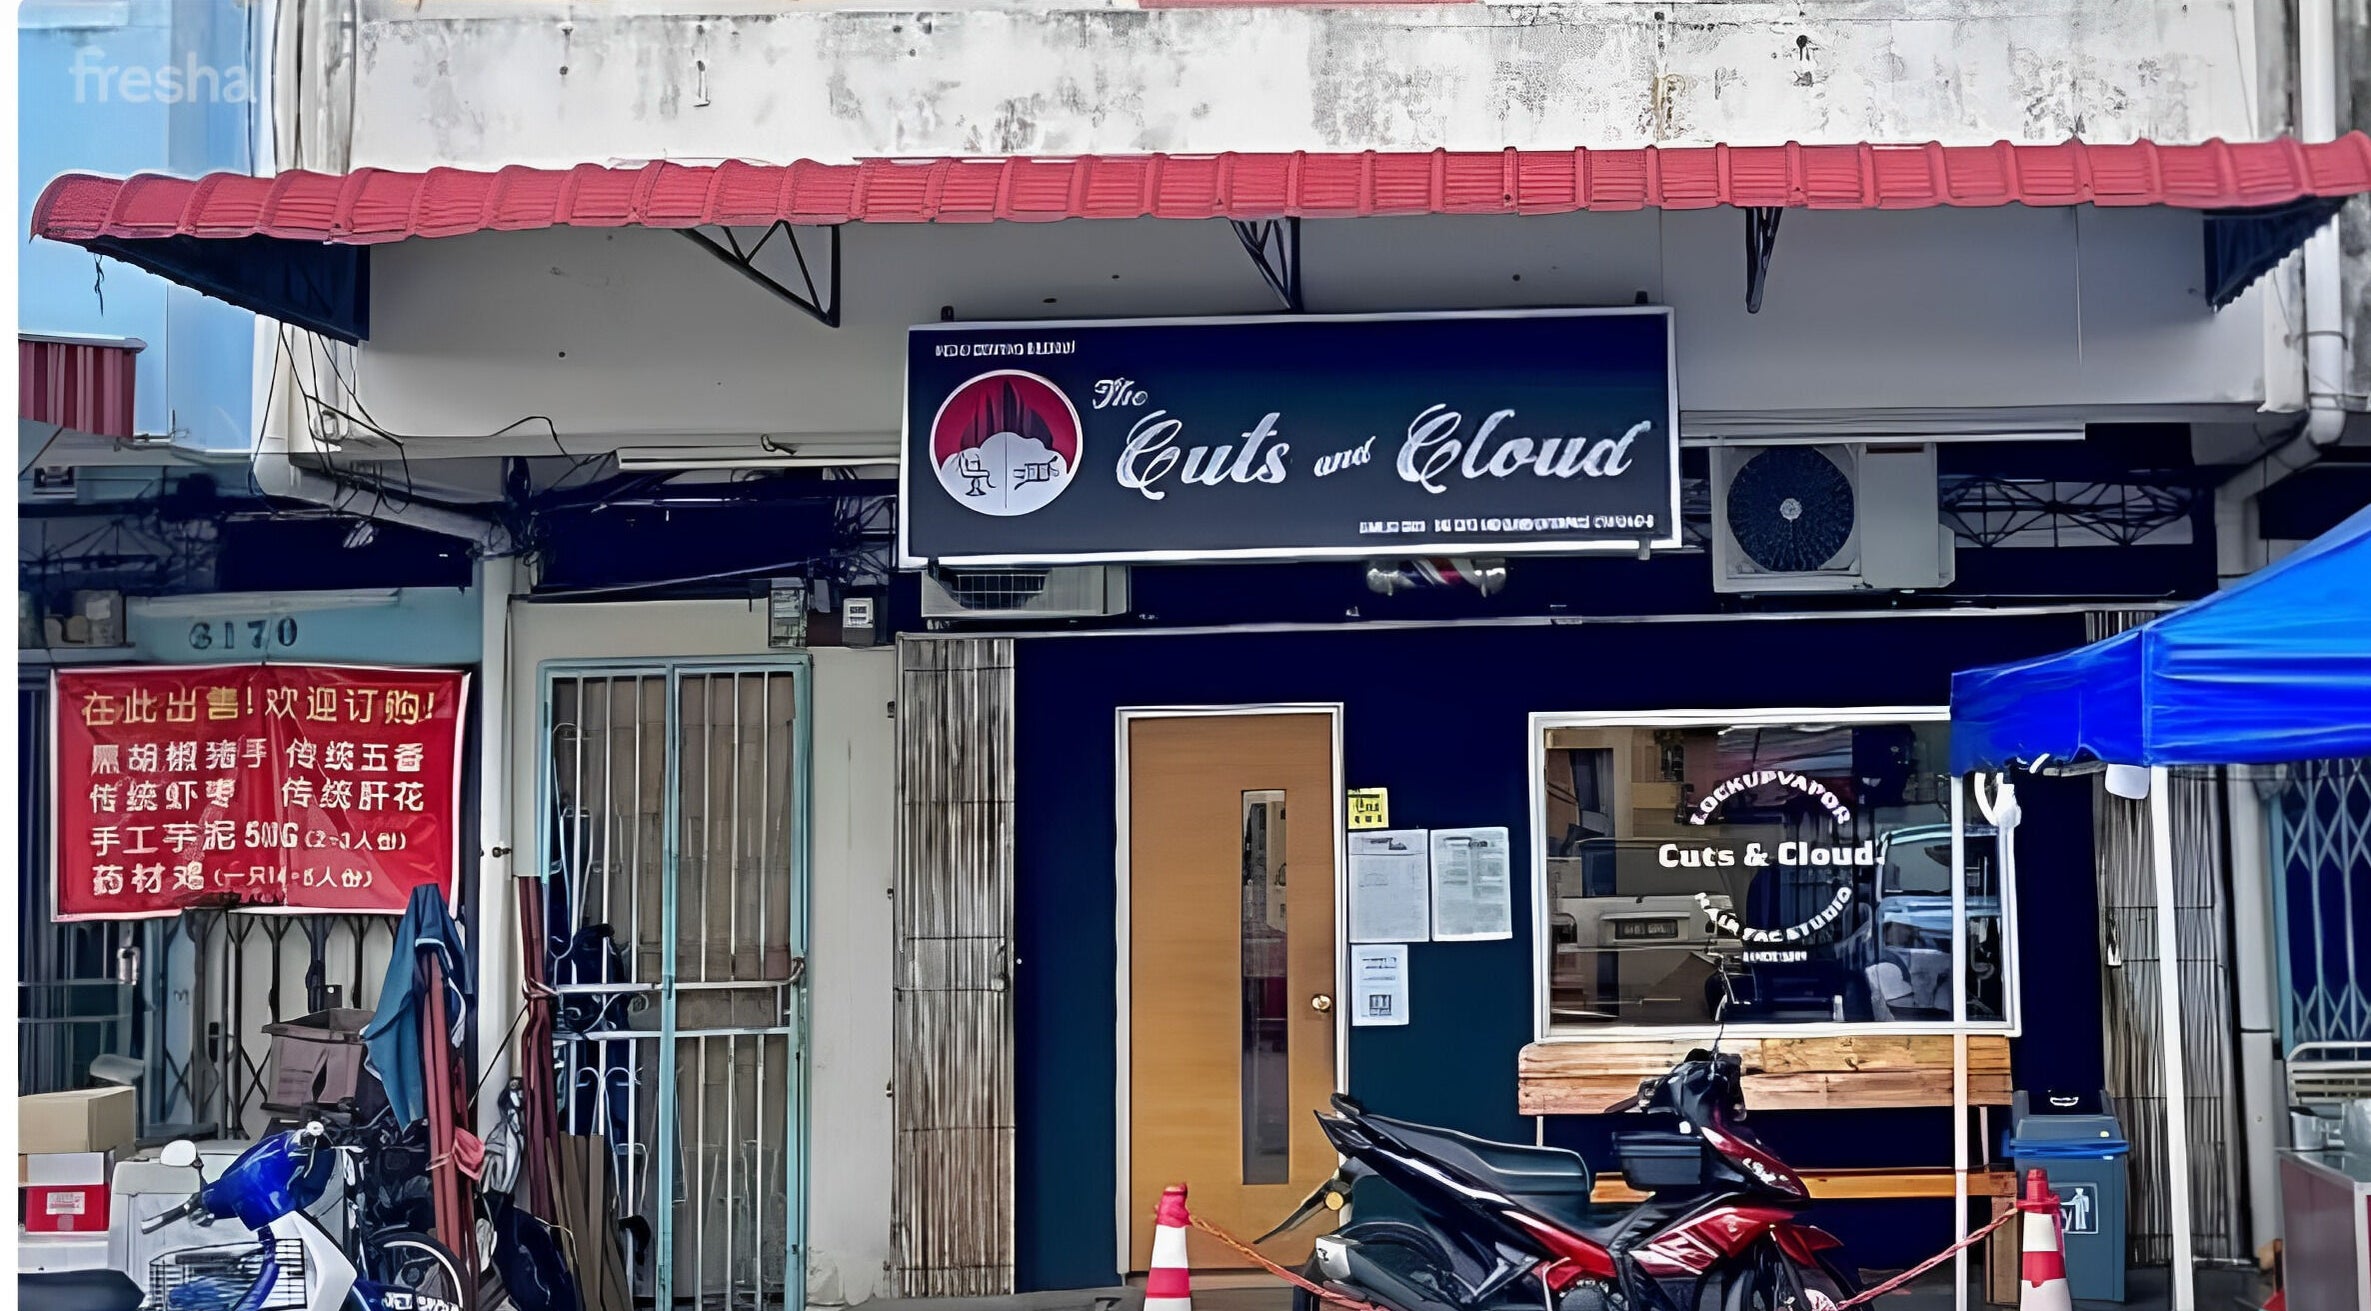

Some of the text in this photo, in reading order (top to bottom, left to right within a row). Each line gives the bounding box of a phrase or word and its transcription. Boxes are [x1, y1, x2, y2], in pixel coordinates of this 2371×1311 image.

[1115, 403, 1653, 500] Cuts and Cloud
[1658, 840, 1874, 868] Cuts & Cloud
